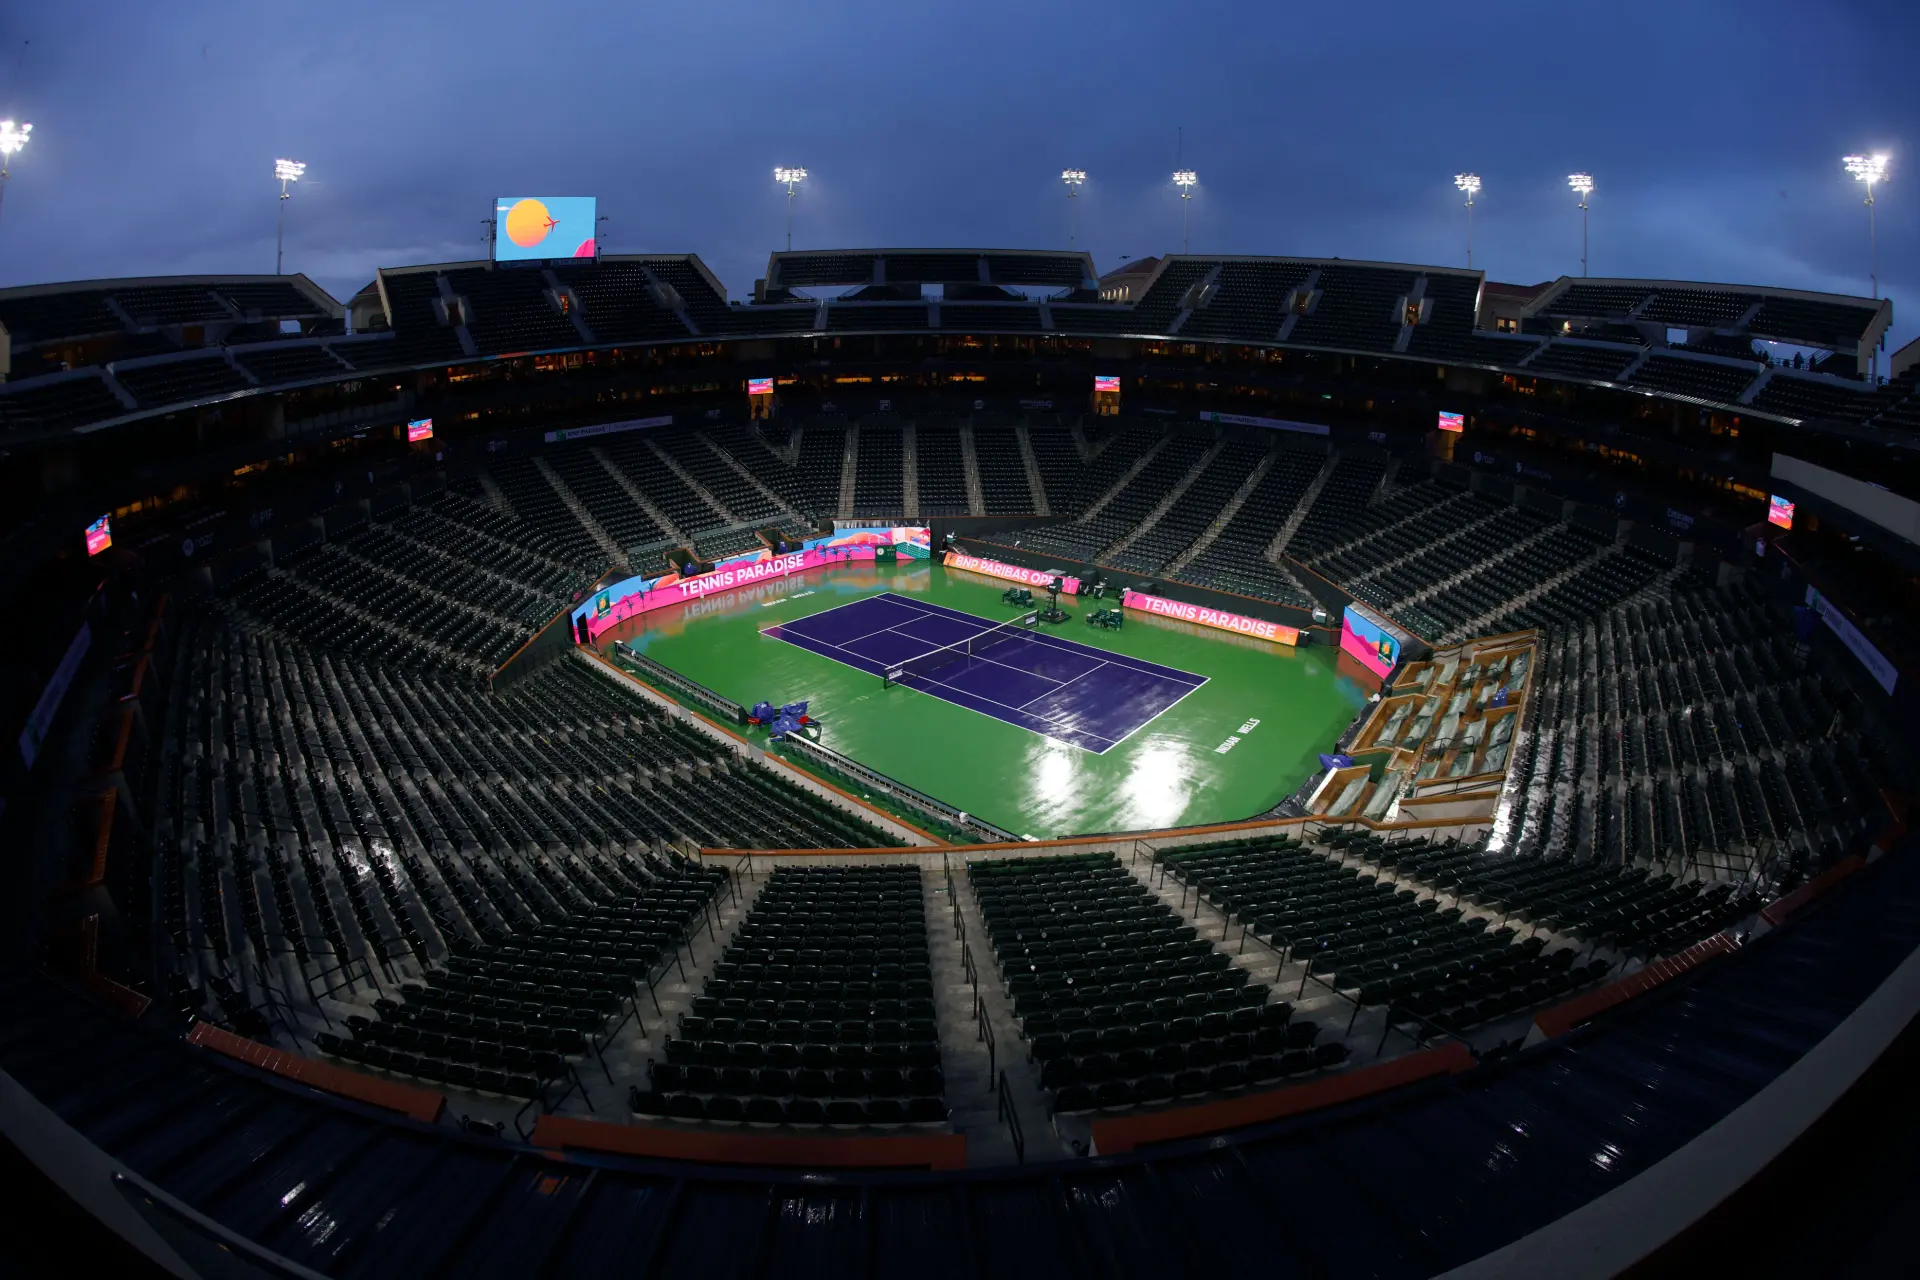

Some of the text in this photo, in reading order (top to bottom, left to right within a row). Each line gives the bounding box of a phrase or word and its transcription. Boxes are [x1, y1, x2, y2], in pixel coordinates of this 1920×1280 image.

[679, 554, 805, 597] TENNIS PARADISE
[955, 555, 1064, 587] BNP PARIBAS OPE
[1144, 597, 1277, 638] TENNIS PARADISE
[1236, 717, 1260, 734] WELLS
